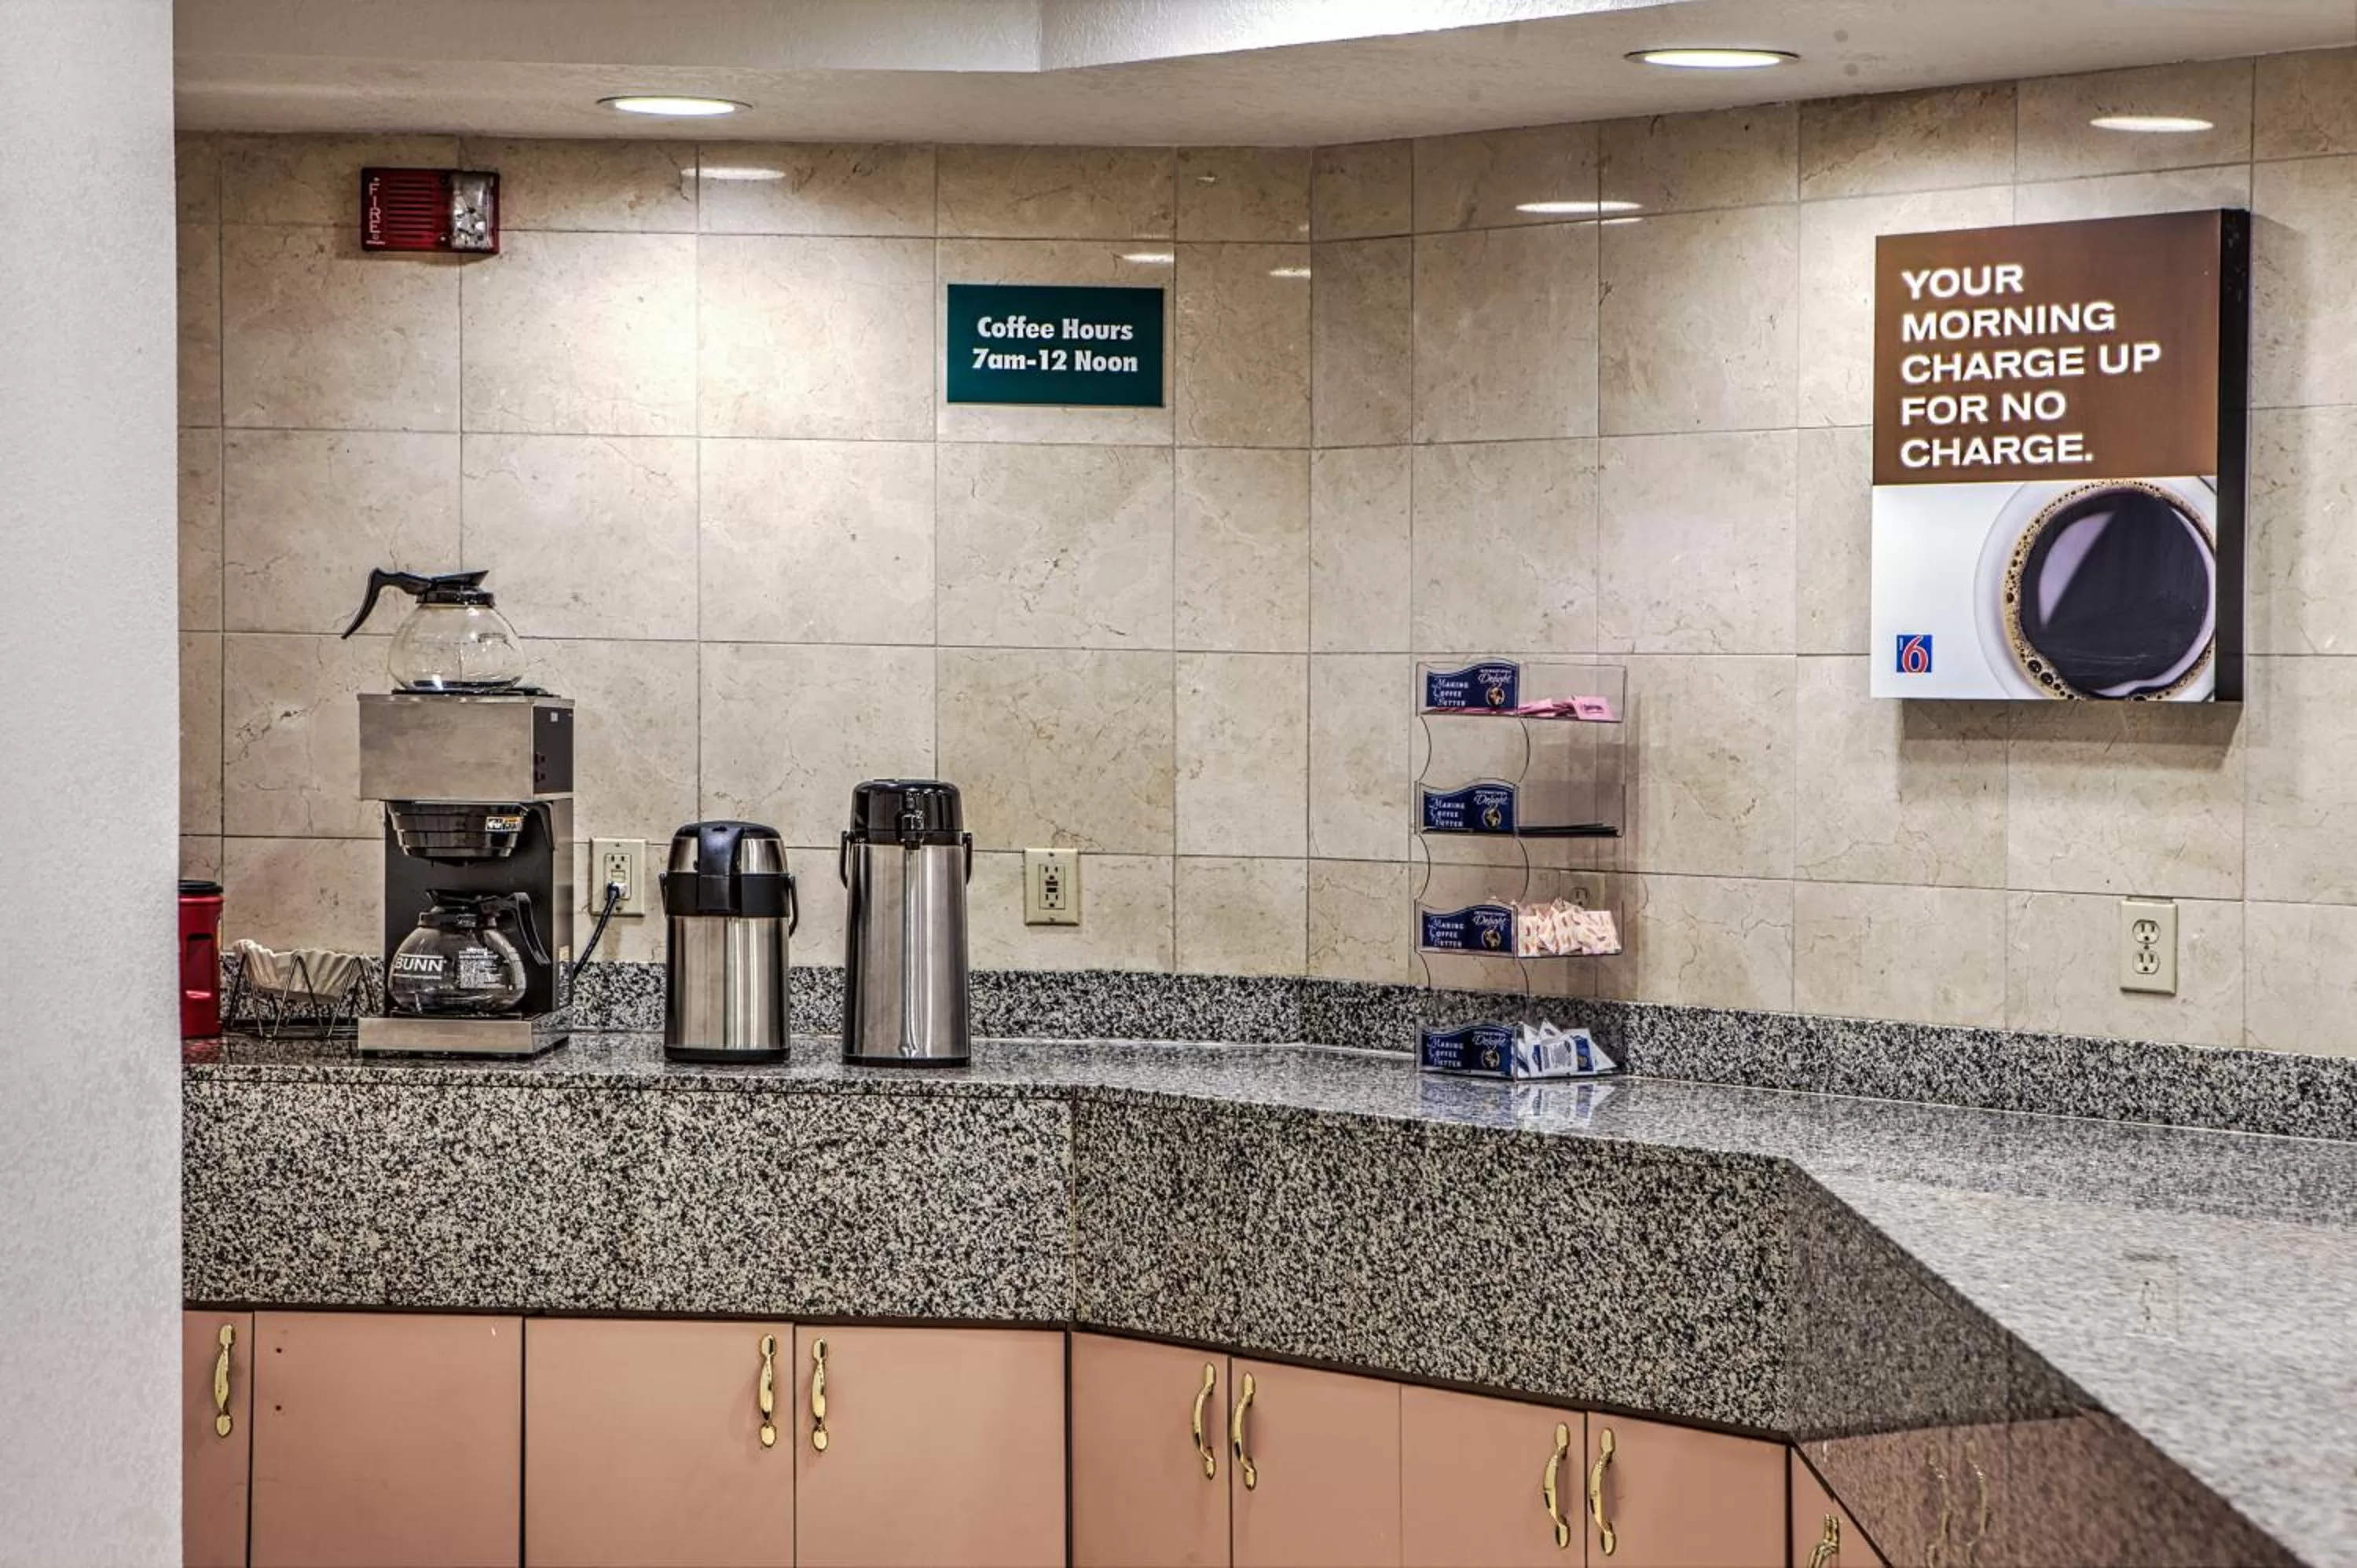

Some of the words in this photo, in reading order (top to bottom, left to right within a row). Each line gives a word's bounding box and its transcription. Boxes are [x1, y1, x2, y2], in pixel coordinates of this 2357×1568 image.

[368, 181, 381, 233] FIRE
[1901, 263, 2025, 300] YOUR
[977, 315, 1055, 339] Coffee
[1062, 318, 1134, 340] Hours
[1901, 301, 2117, 343] MORNING
[971, 348, 1067, 371] 7am-12
[1074, 350, 1138, 372] Noon
[1901, 346, 2085, 384] CHARGE
[2099, 341, 2162, 375] UP
[1901, 394, 1989, 427] FOR
[2001, 390, 2067, 423] NO
[1900, 433, 2095, 468] CHARGE.
[1901, 634, 1929, 673] 6
[395, 957, 442, 973] BUNN
